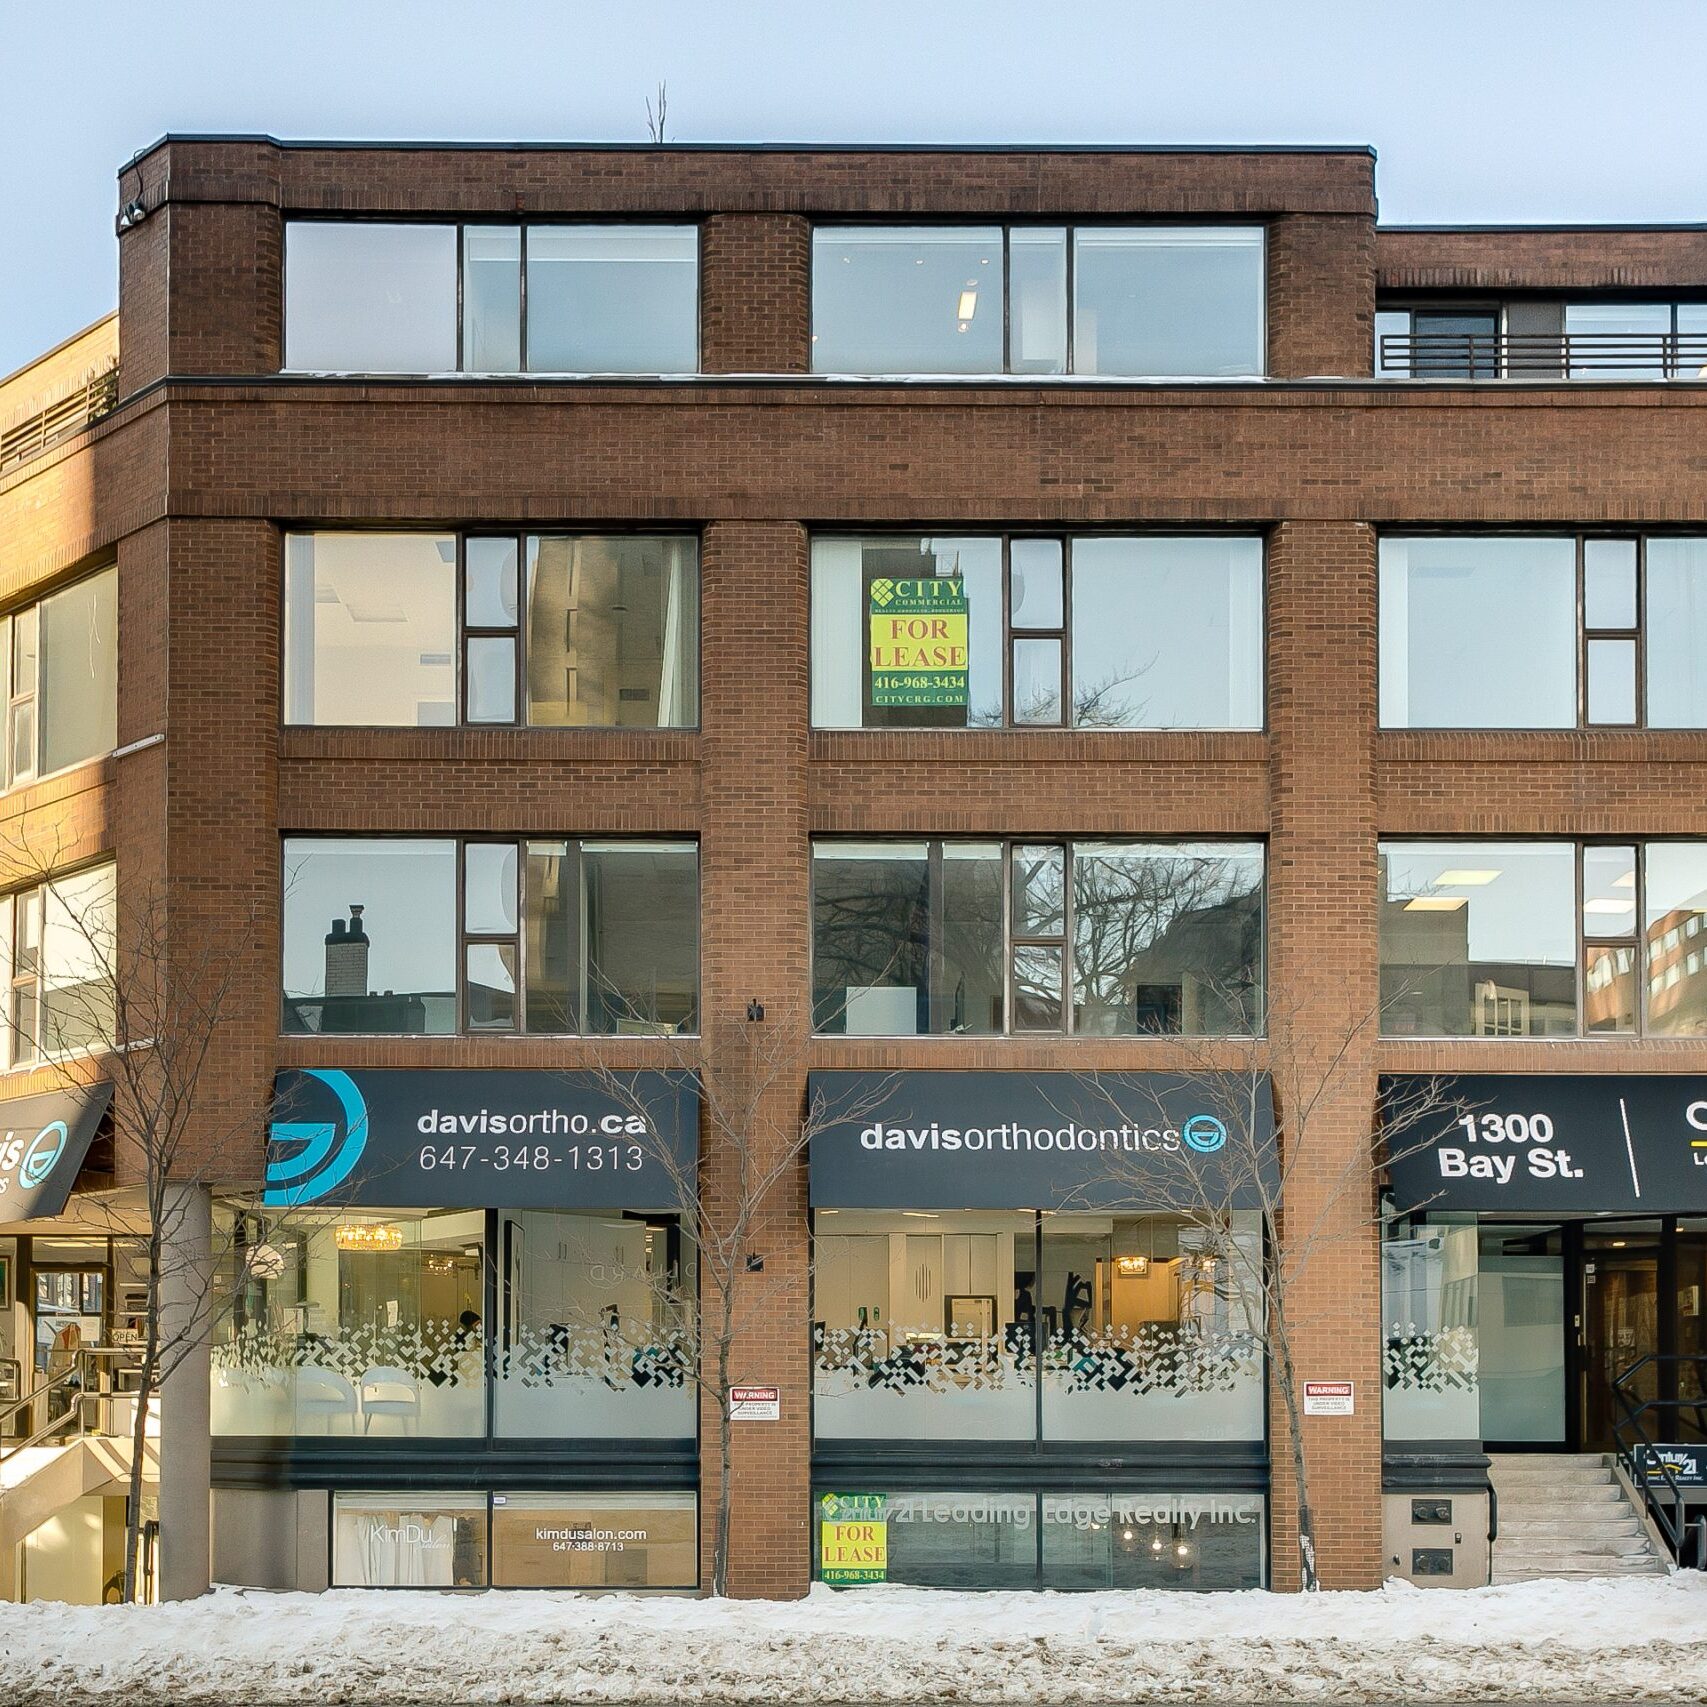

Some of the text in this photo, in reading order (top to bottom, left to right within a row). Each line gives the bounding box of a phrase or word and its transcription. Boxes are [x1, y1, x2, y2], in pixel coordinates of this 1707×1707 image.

[895, 580, 962, 597] CITY
[890, 619, 949, 640] FOR
[874, 646, 966, 667] LEASE
[874, 676, 965, 689] 416-968-3434
[876, 695, 963, 703] CITYCRG.COM
[417, 1109, 647, 1134] davisortho.ca
[1459, 1114, 1554, 1143] 1300
[860, 1123, 1181, 1151] davisorthodontics
[420, 1146, 643, 1171] 647-348-1313
[1438, 1148, 1584, 1184] Bay St.
[112, 1331, 138, 1341] OPEN
[734, 1391, 775, 1399] WARNING
[1308, 1386, 1349, 1394] WARNING
[840, 1496, 884, 1508] CITY
[923, 1499, 1030, 1530] Leading
[1211, 1499, 1256, 1523] Inc.
[370, 1525, 432, 1543] KimDu
[535, 1528, 647, 1539] kimdusalon.com
[835, 1526, 874, 1541] FOR
[824, 1547, 885, 1562] LEASE
[825, 1571, 885, 1579] 416-968-3434
